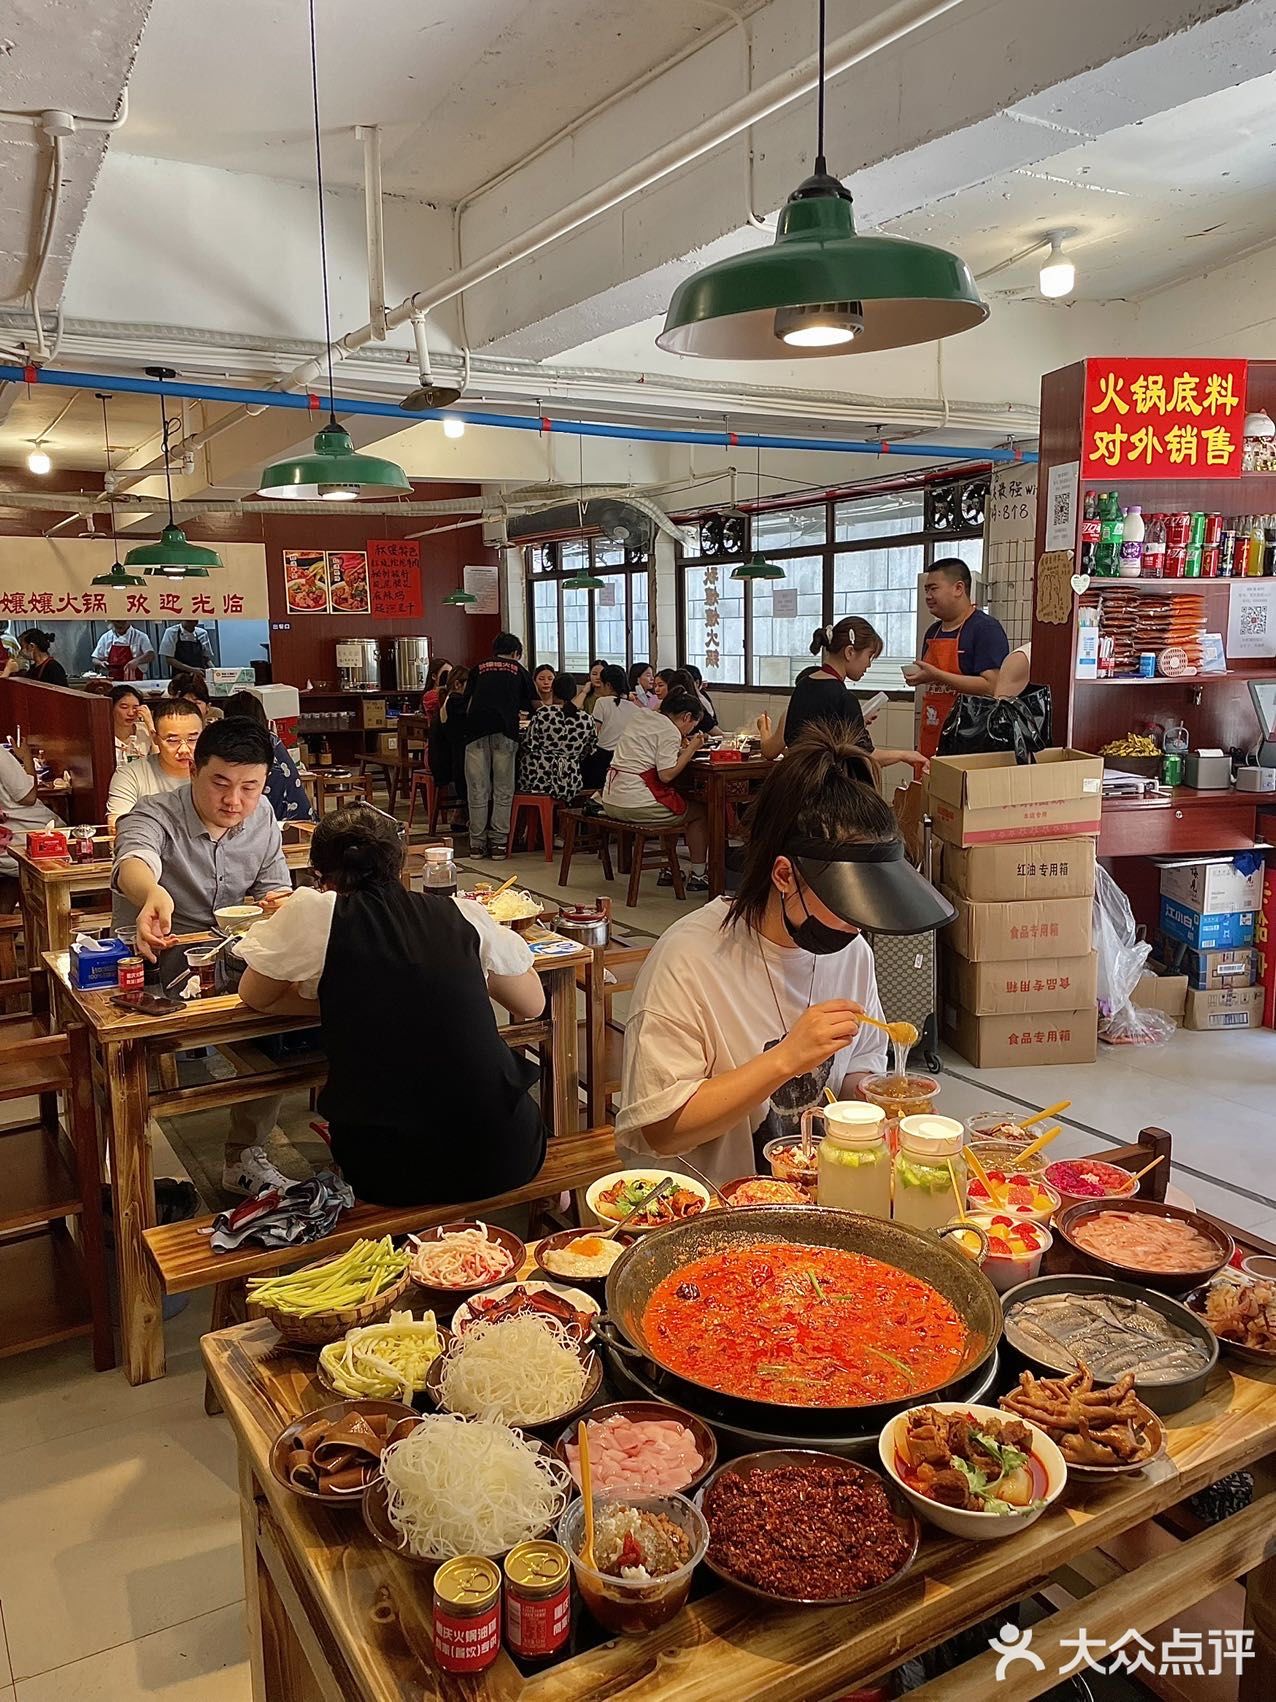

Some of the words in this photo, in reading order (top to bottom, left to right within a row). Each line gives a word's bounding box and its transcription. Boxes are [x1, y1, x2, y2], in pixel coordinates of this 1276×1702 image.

[1091, 371, 1239, 416] 火锅底料
[1088, 423, 1236, 466] 对外销售
[126, 593, 244, 615] 欢迎光临
[1017, 863, 1036, 876] 红油
[1039, 862, 1069, 876] 专用箱
[1010, 923, 1060, 940] 食品专用箱
[1006, 976, 1070, 993] 食品专用箱
[1008, 1029, 1071, 1045] 食品专用箱
